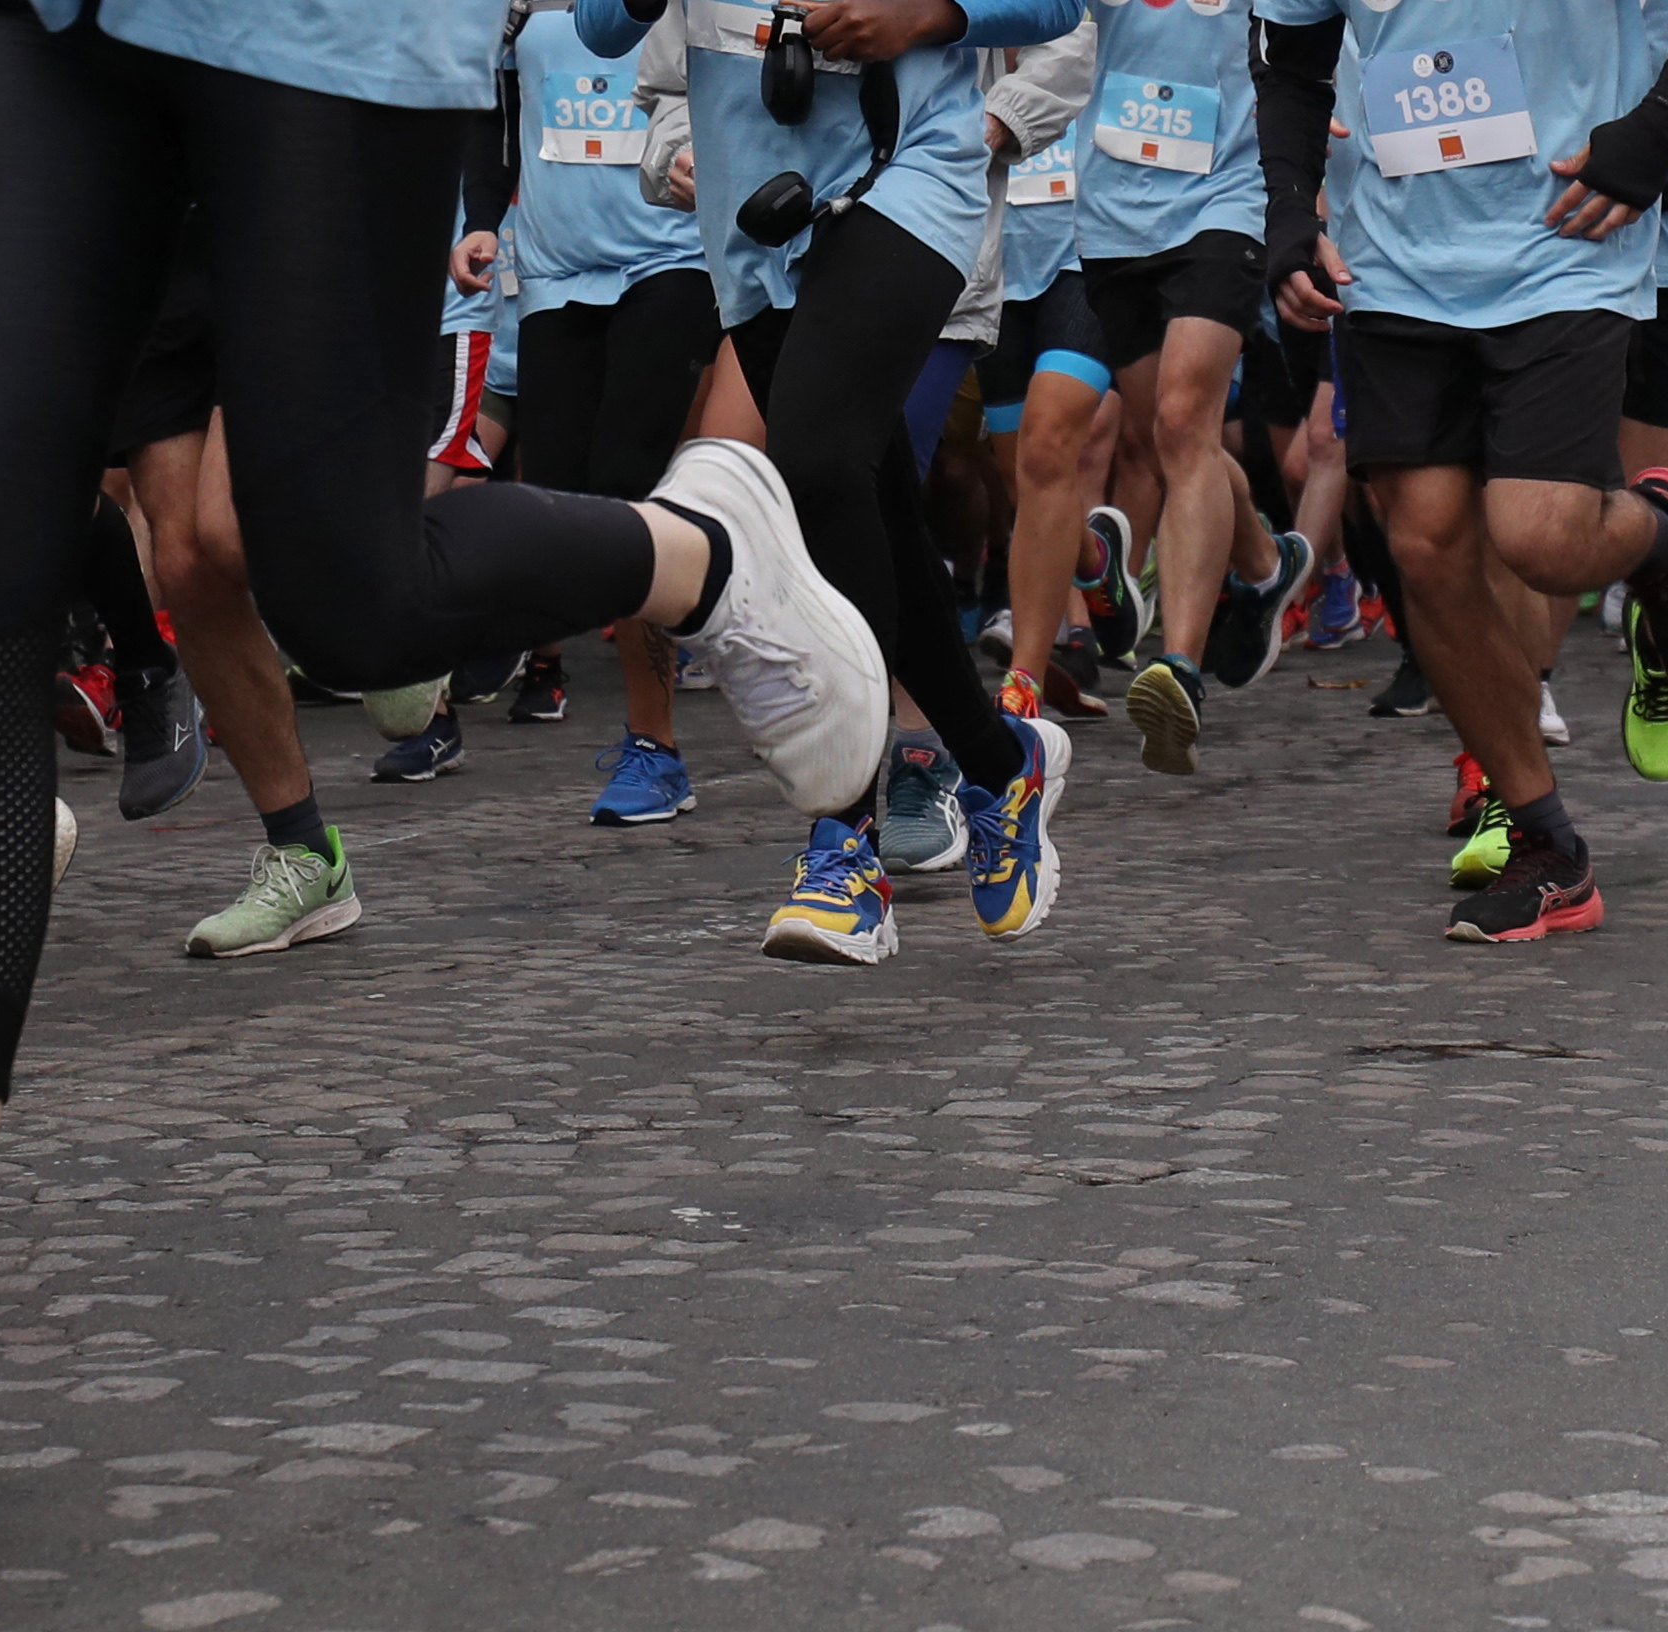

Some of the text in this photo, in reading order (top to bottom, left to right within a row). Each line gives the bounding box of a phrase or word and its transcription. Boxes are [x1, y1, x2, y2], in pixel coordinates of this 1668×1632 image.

[554, 97, 635, 128] 3107
[1119, 99, 1193, 137] 3215
[1393, 76, 1492, 125] 1388
